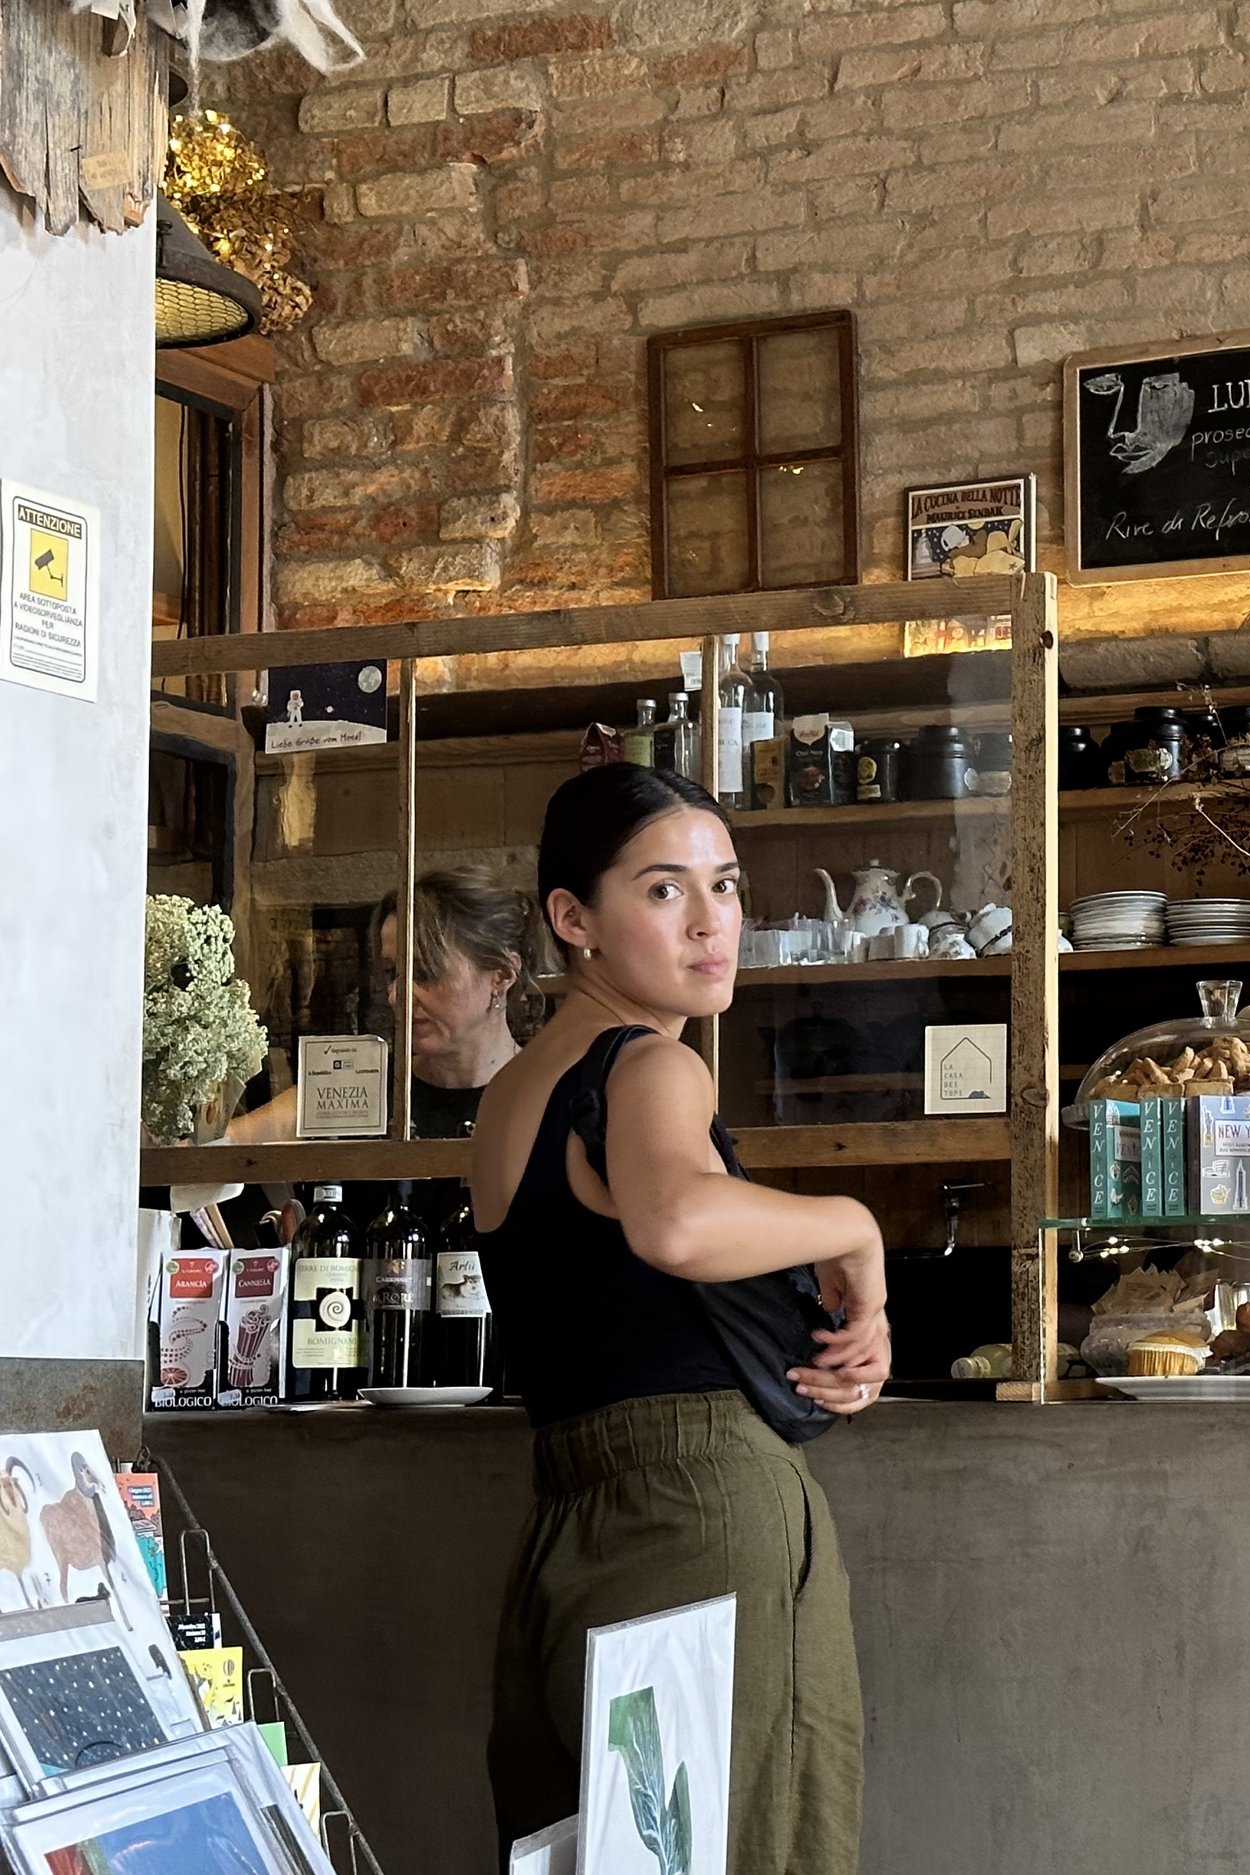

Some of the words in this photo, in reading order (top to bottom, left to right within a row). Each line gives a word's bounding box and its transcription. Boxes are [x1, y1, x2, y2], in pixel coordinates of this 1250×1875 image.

[19, 507, 81, 538] ATTENZIONE
[316, 1086, 368, 1100] VENEZIA
[316, 1099, 369, 1110] MAXIMA
[1218, 1124, 1241, 1139] NEW
[1092, 1104, 1105, 1205] VENICE
[1142, 1101, 1157, 1202] VENICE
[1166, 1101, 1180, 1202] VENICE
[175, 1279, 207, 1288] ARANCIA
